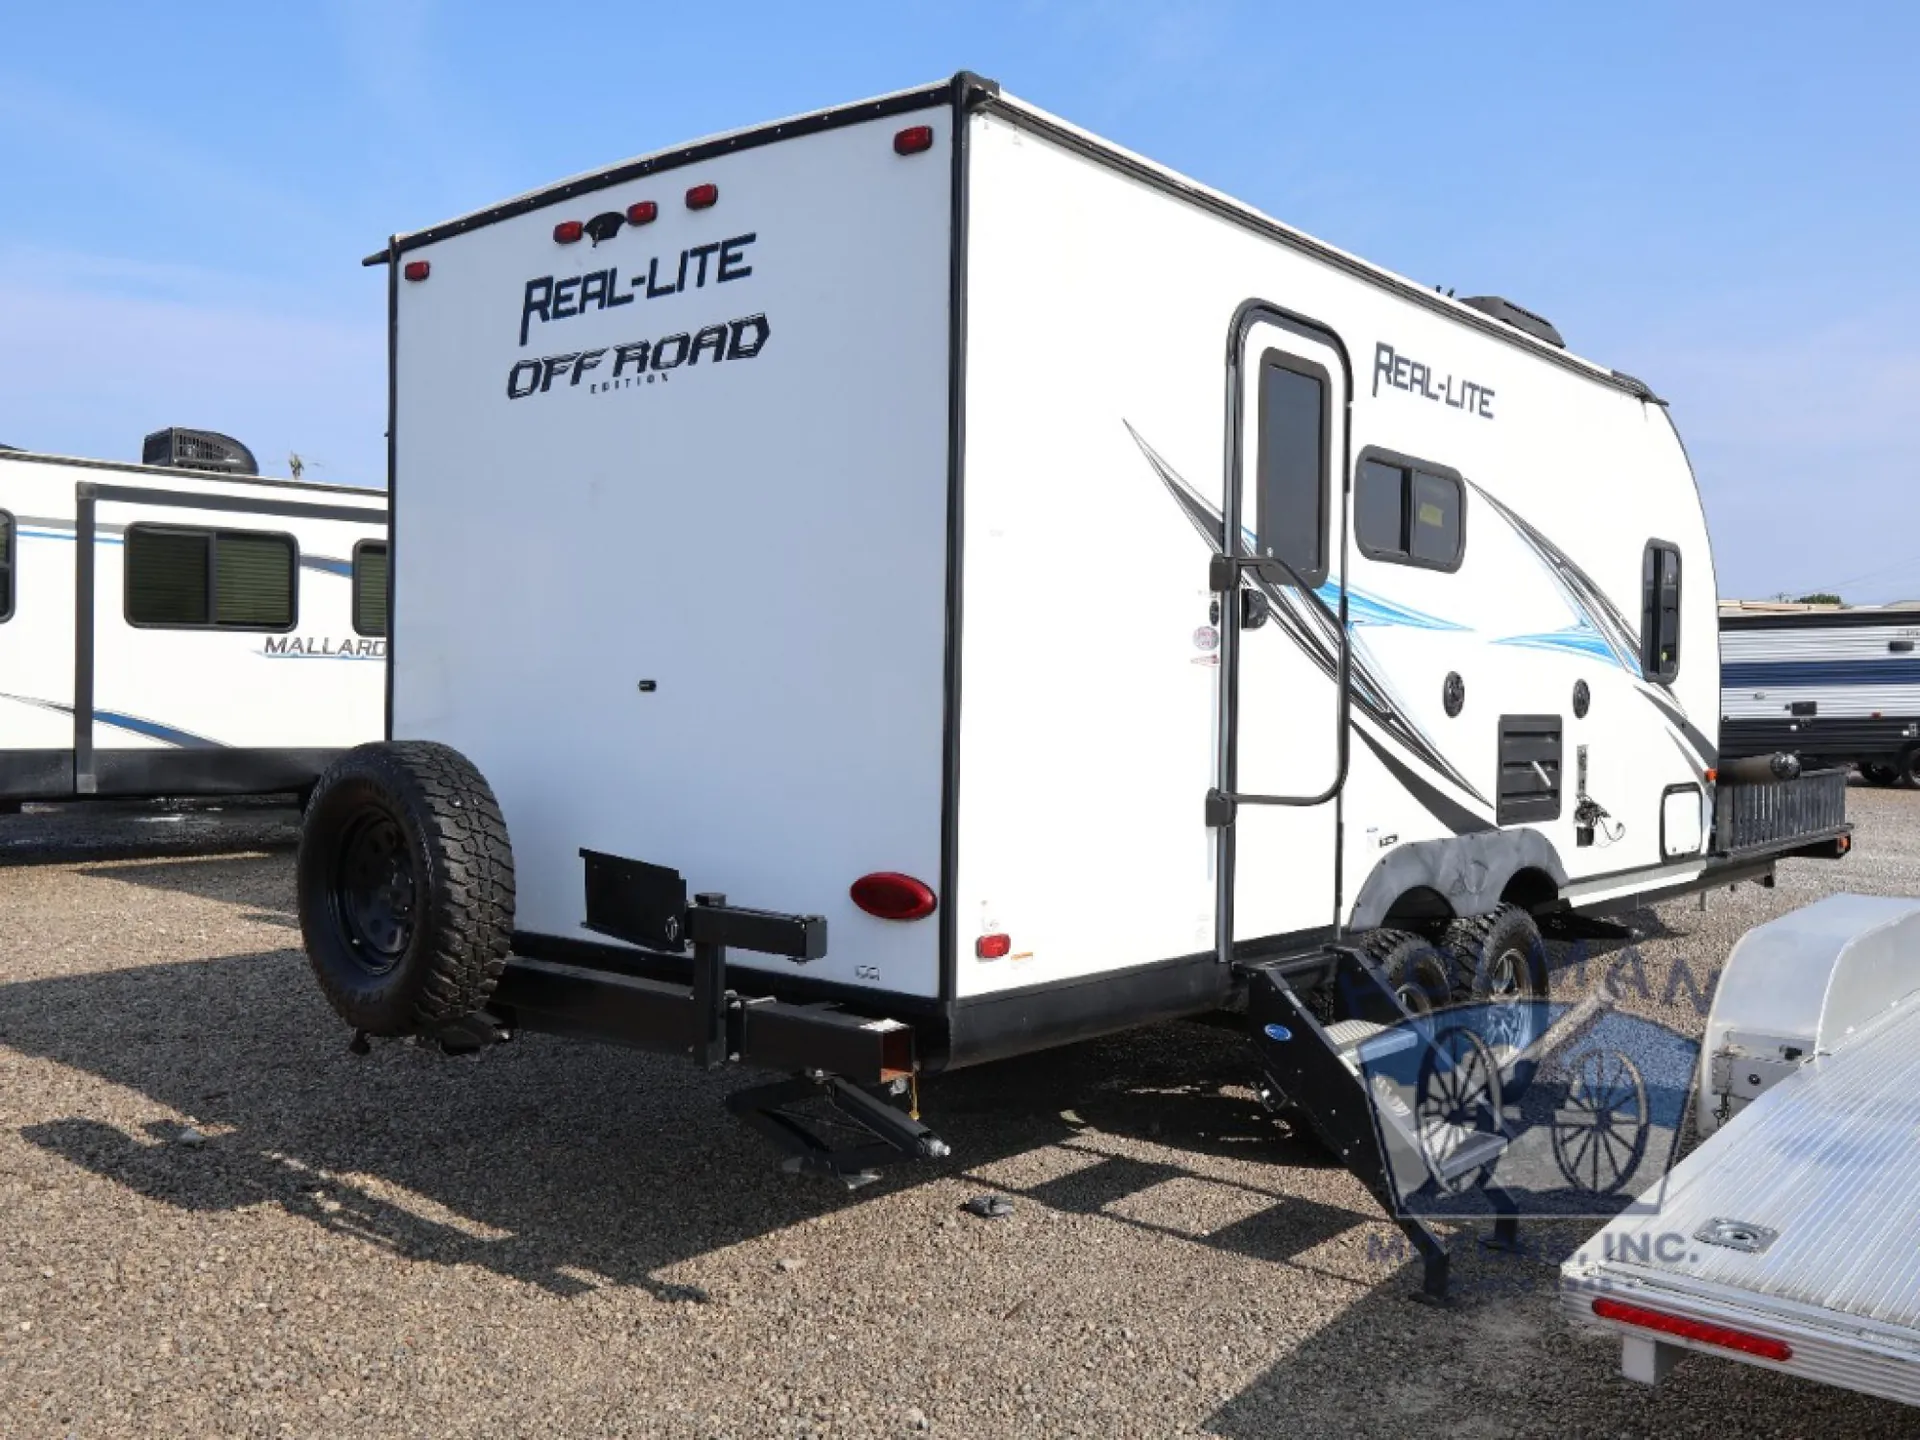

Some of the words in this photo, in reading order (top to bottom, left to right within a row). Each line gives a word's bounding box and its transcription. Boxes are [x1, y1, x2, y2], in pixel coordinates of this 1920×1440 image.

[519, 232, 757, 347] REAL-LITE
[507, 347, 609, 400] OFF
[611, 312, 771, 378] ROAD
[1372, 341, 1495, 419] REAL-LITE
